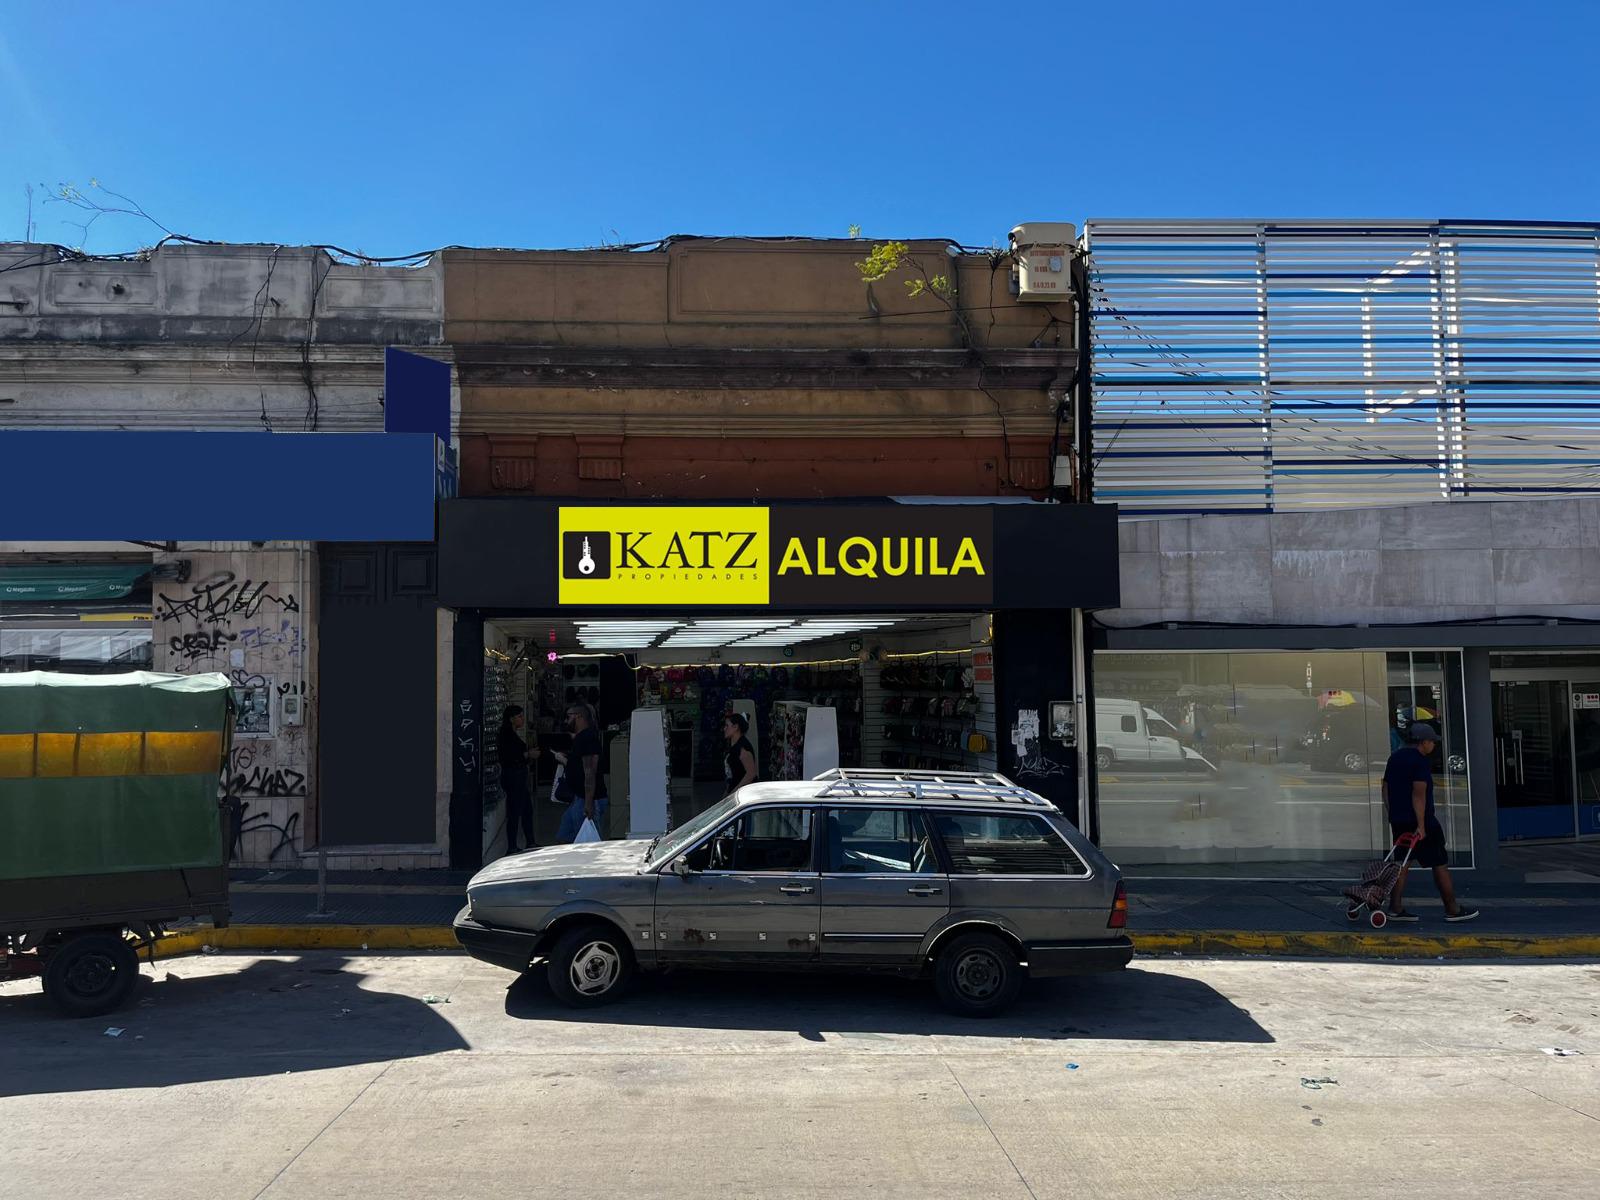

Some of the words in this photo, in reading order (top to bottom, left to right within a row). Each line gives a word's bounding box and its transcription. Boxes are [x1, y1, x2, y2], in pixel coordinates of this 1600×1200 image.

[615, 531, 758, 569] KATZ
[777, 536, 986, 578] ALQUILA
[617, 573, 758, 581] PROPIEDADES
